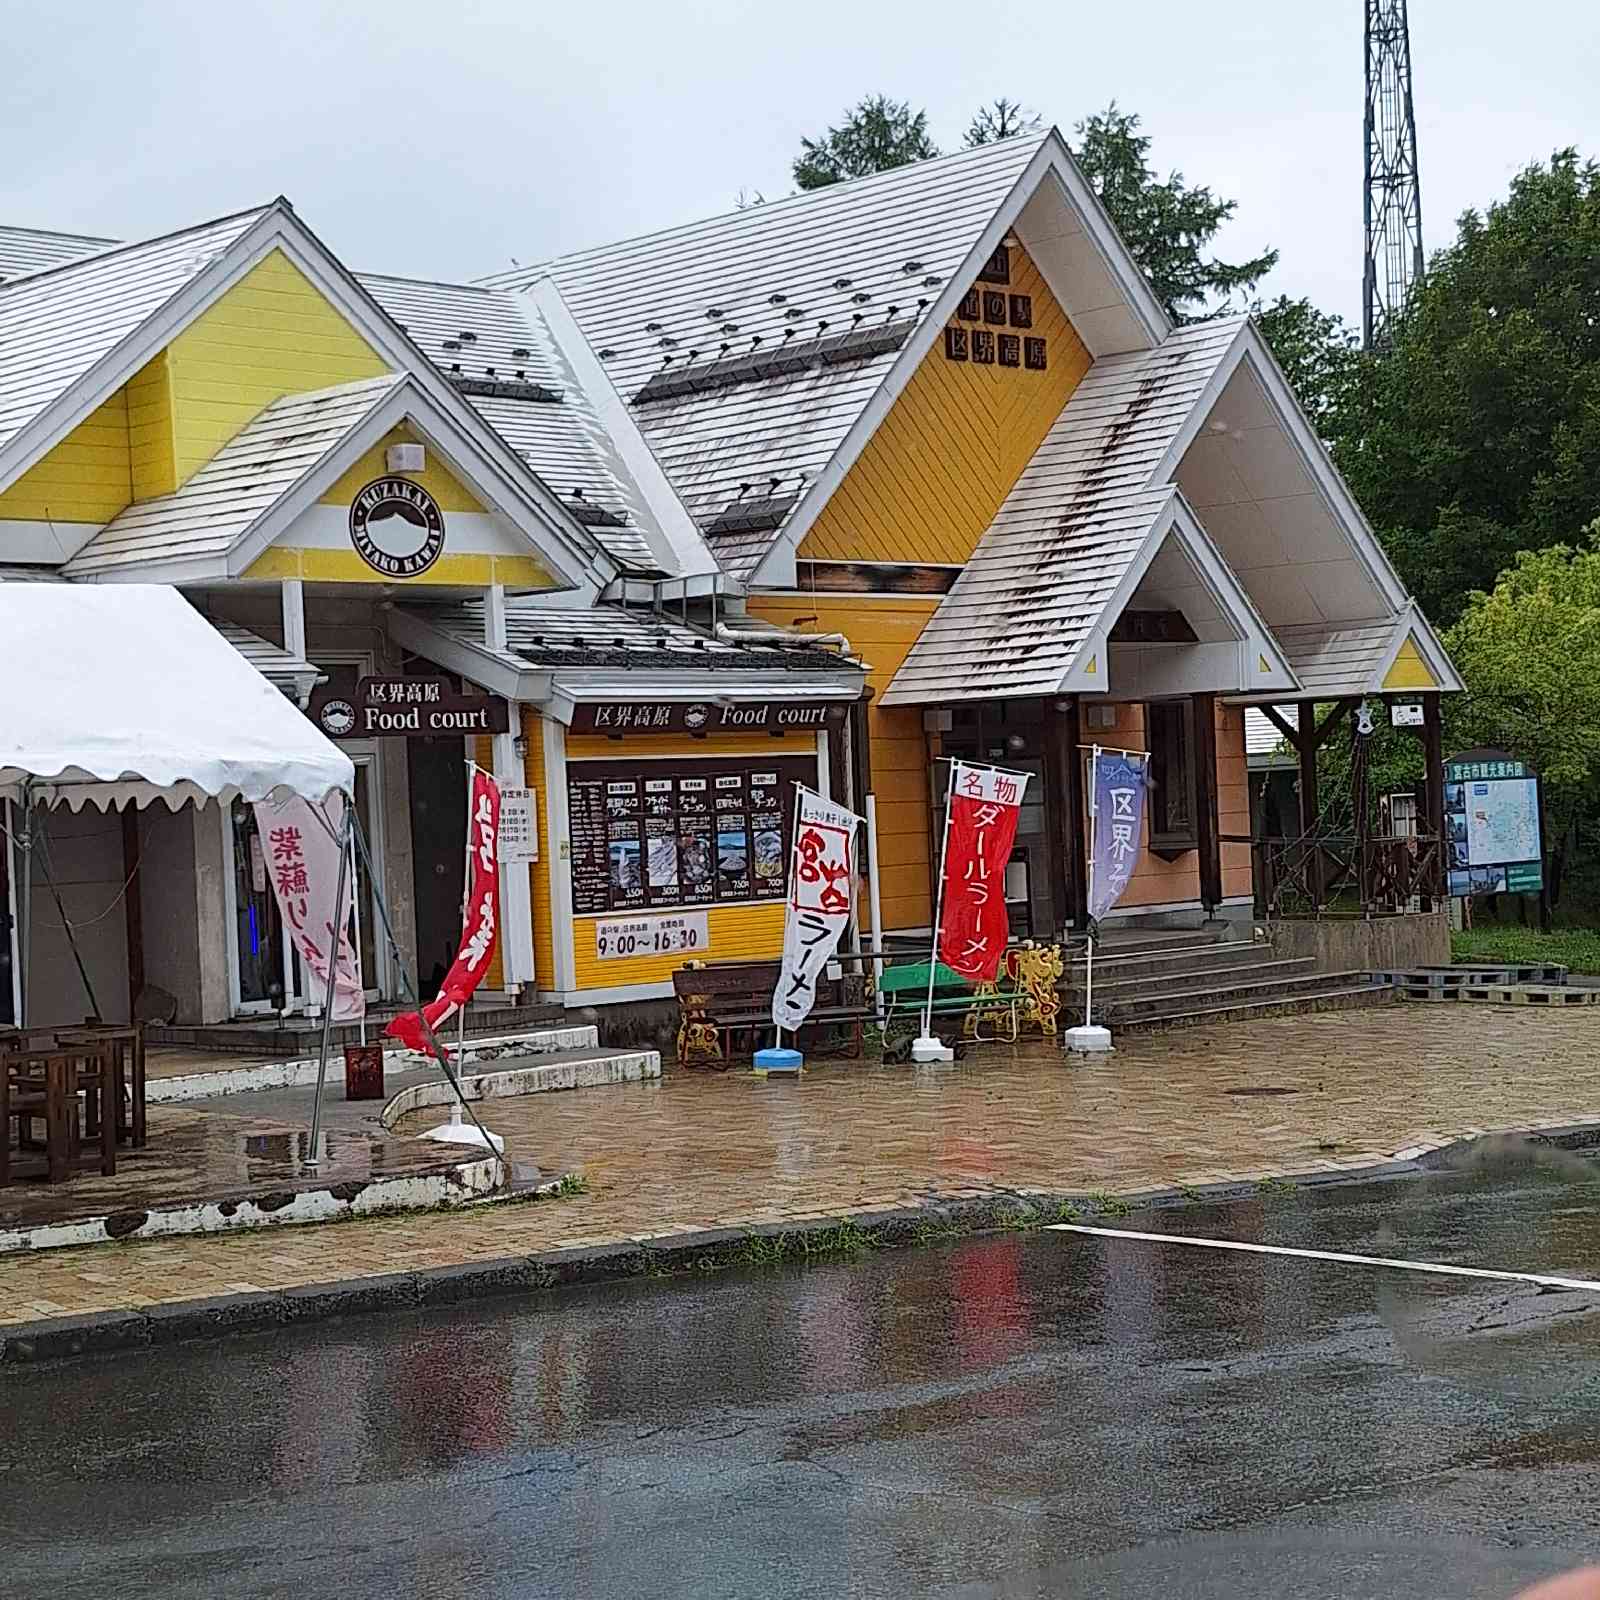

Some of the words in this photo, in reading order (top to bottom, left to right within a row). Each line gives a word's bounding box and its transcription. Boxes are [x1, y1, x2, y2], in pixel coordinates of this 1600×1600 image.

[951, 329, 1044, 365] 区界高原
[360, 482, 430, 512] KUZAKAI
[404, 528, 441, 572] KAWAI
[370, 683, 440, 703] 区界高原
[364, 708, 420, 729] Food
[430, 708, 489, 728] court
[594, 705, 672, 727] 区界高原
[719, 705, 769, 725] Food
[778, 705, 828, 724] court
[962, 771, 1018, 804] 名物
[953, 804, 1006, 973] ダールラーメン
